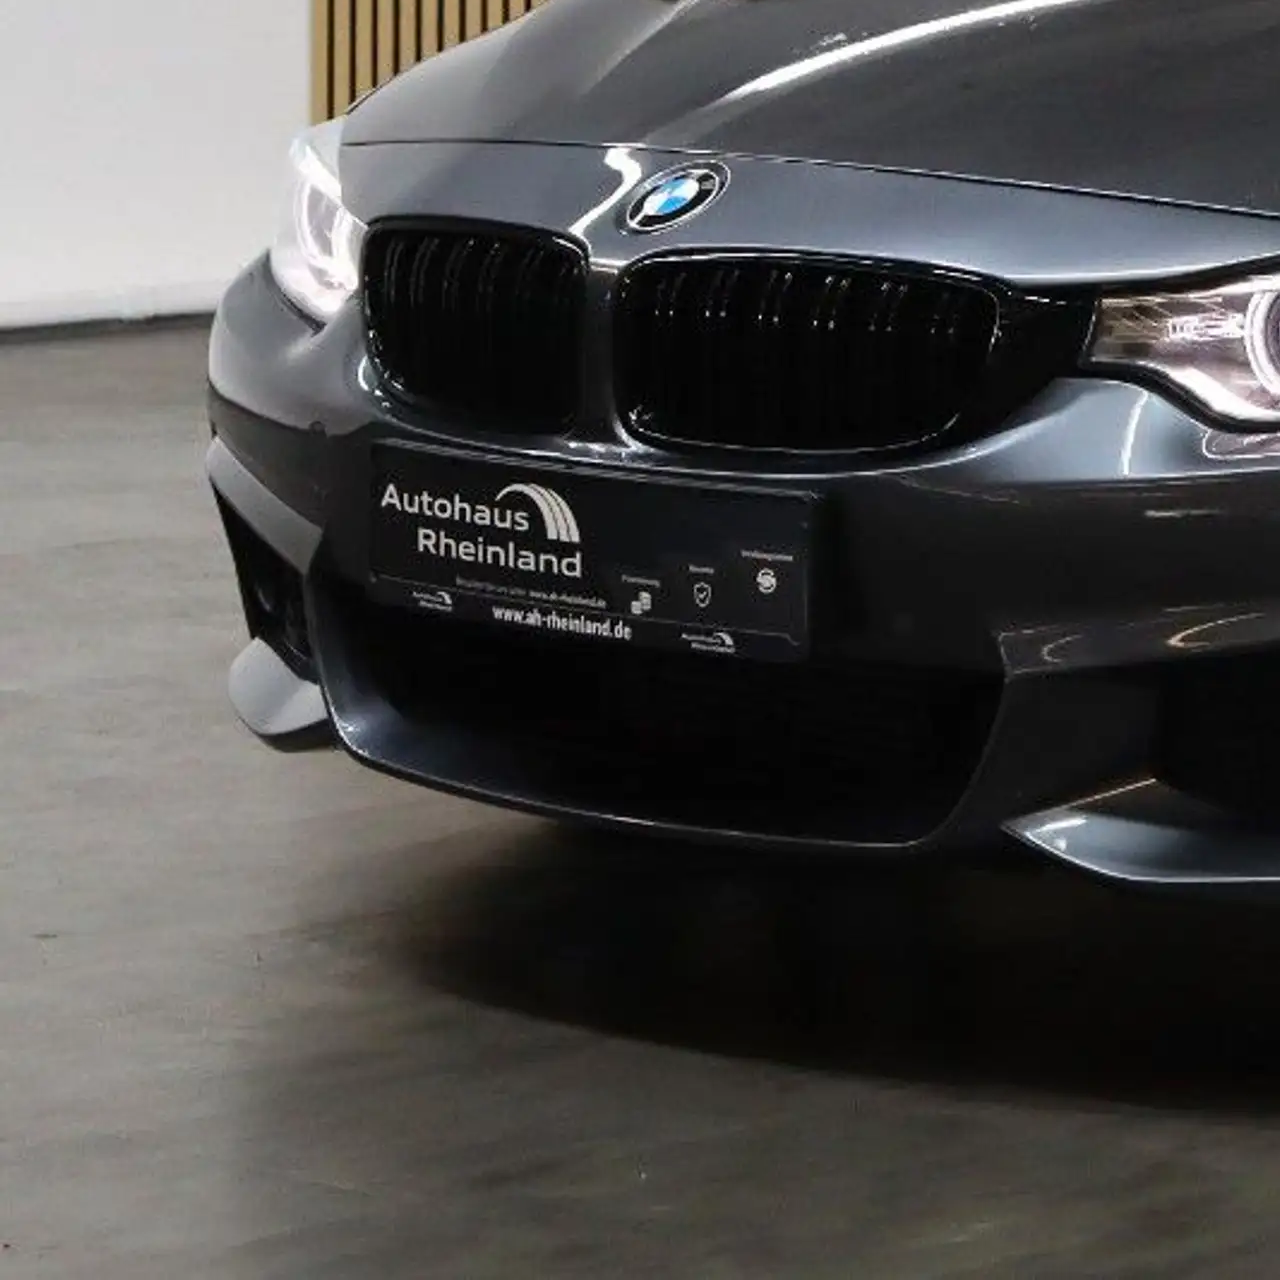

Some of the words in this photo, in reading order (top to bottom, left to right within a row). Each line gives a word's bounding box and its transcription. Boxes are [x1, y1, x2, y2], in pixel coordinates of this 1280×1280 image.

[380, 482, 530, 532] Autohaus
[416, 526, 583, 579] Rheinland
[491, 604, 633, 642] www.ah-rheinland.de
